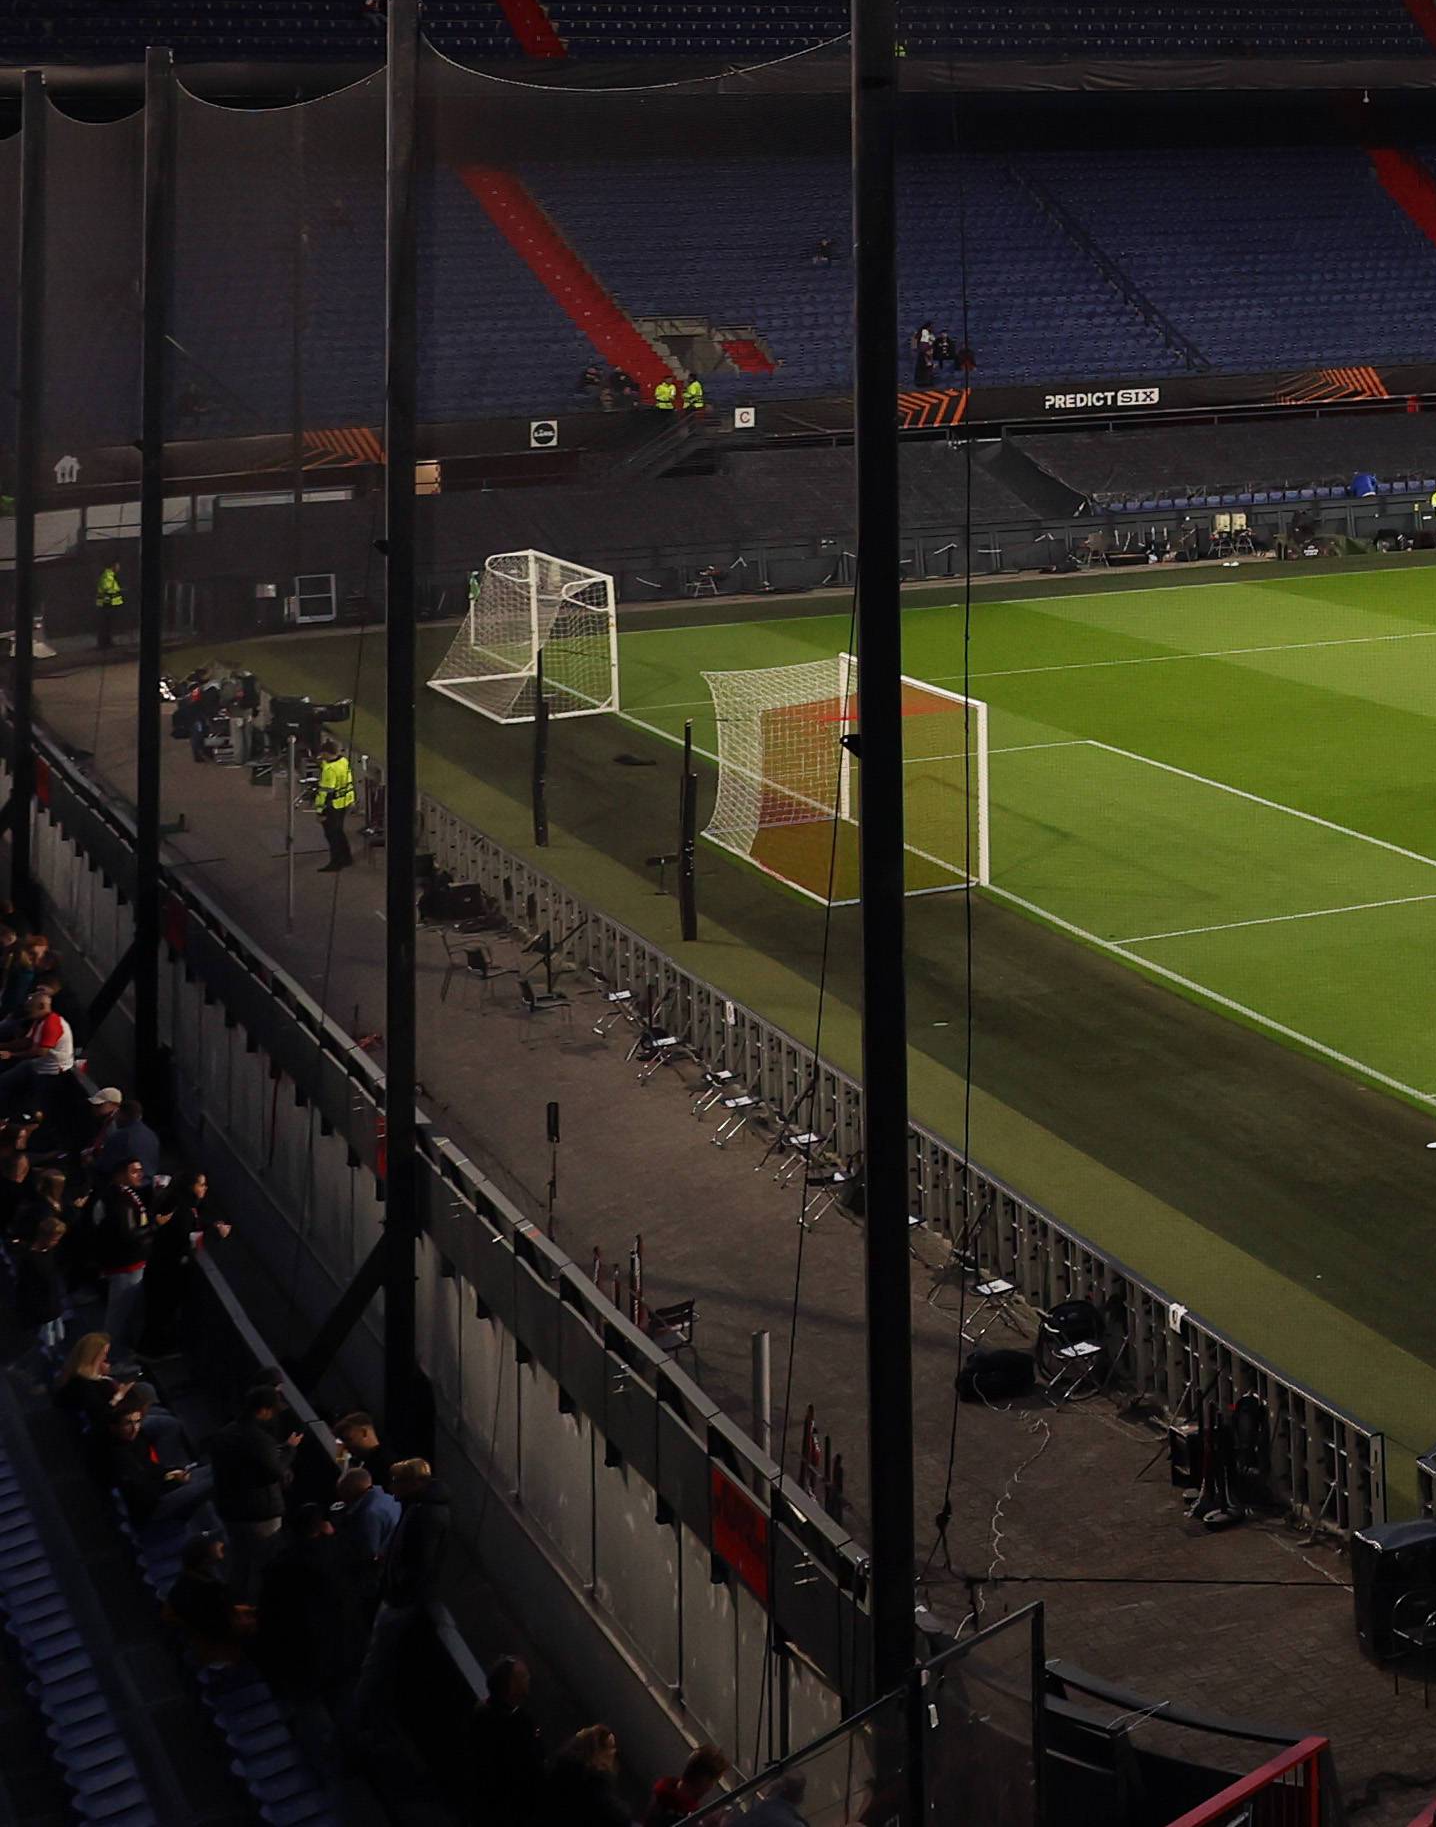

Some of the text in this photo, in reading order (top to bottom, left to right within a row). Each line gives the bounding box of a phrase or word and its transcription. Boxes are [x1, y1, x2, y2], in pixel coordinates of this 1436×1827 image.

[1044, 391, 1156, 410] PREDICT SIX
[739, 410, 751, 424] C
